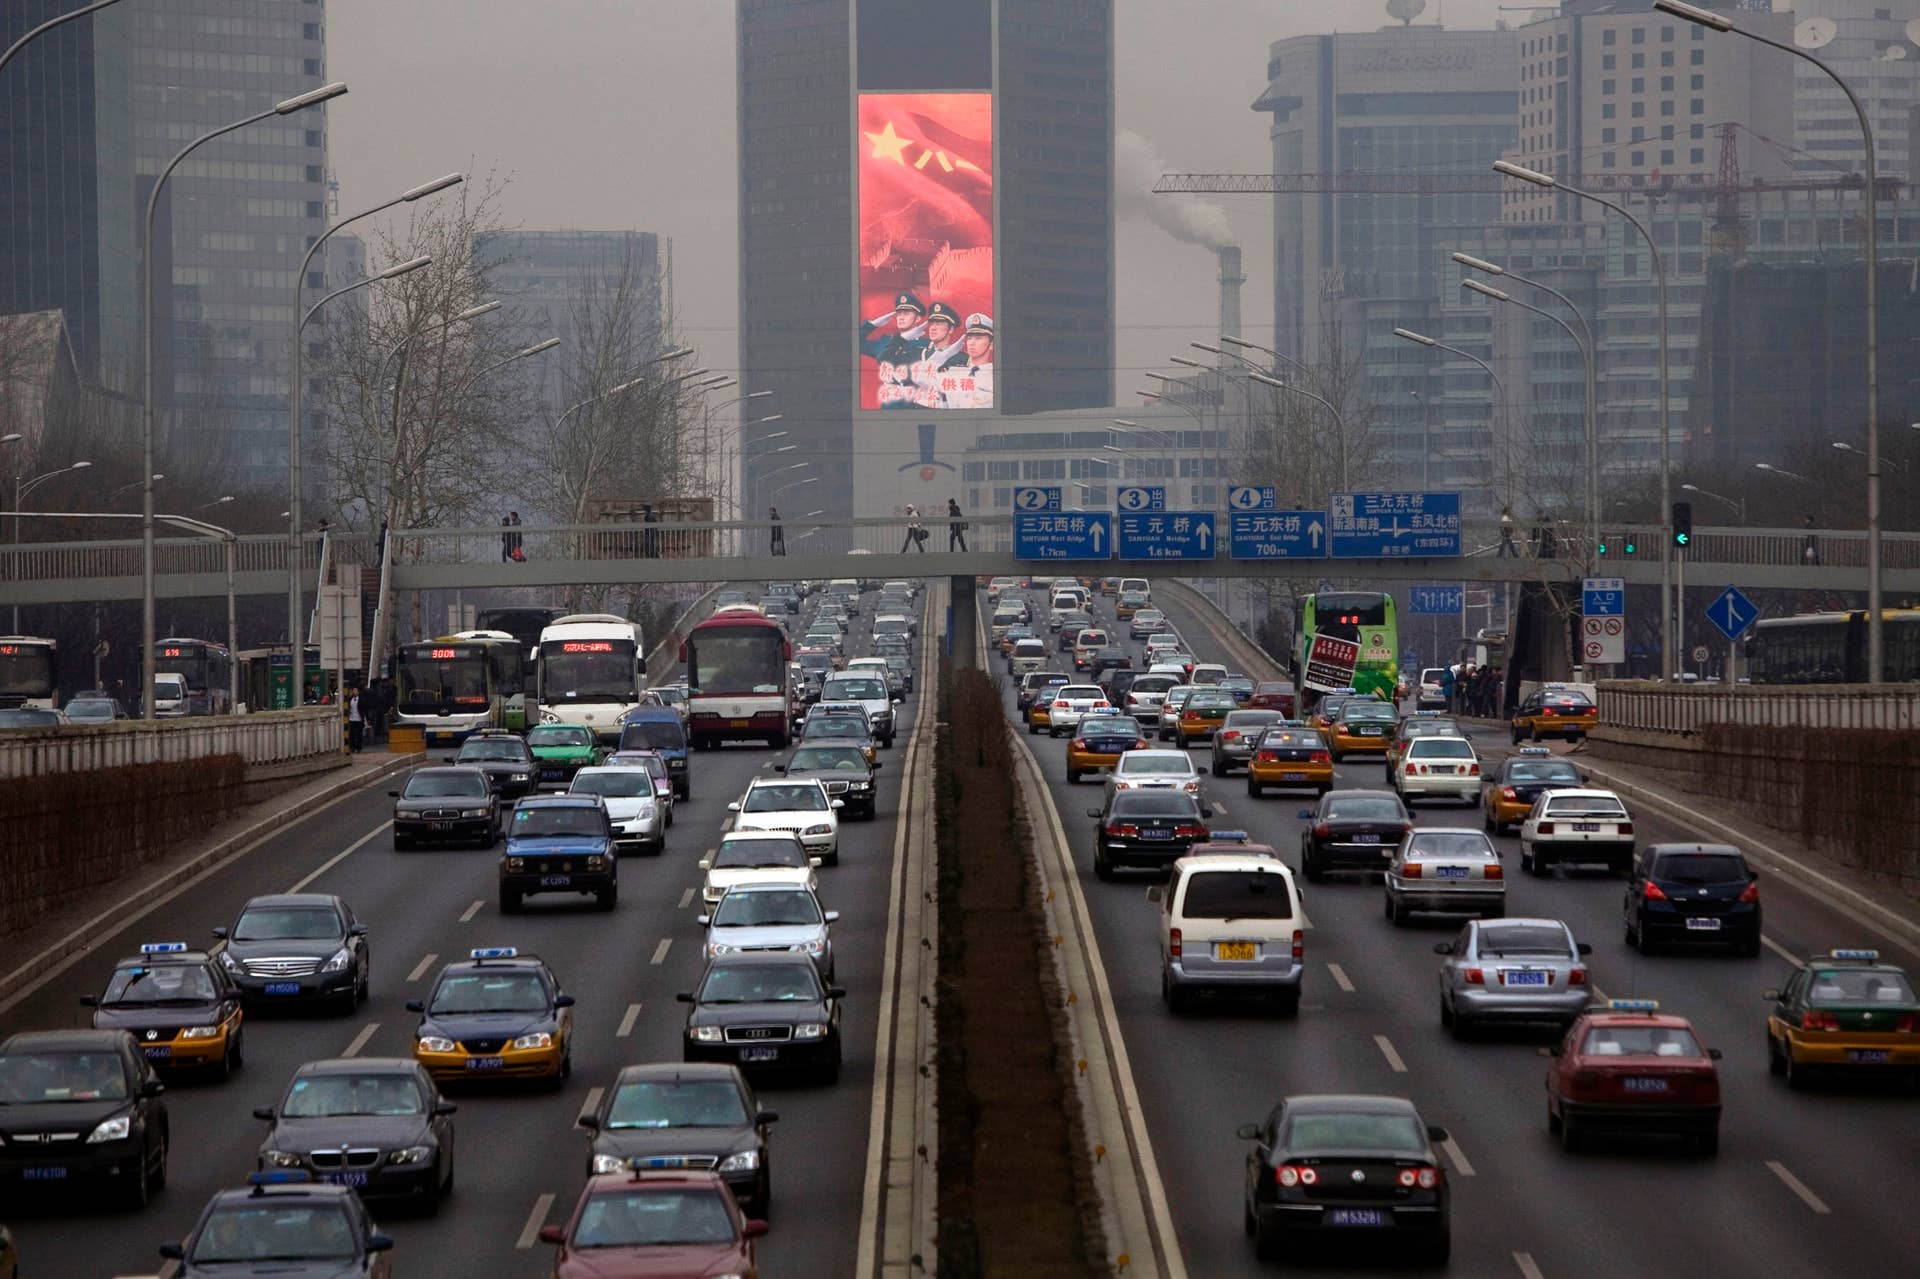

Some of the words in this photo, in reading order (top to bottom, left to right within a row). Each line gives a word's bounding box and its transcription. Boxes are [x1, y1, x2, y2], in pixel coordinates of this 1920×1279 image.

[1353, 48, 1474, 71] Microsoft
[1026, 491, 1038, 507] 2
[1048, 489, 1059, 509] 出口
[1129, 491, 1141, 507] 3
[1152, 489, 1163, 509] 出口
[1240, 490, 1252, 506] 4
[1263, 488, 1274, 508] 出口
[1365, 494, 1424, 508] 三元东桥
[1021, 517, 1086, 532] 三元西桥
[1235, 516, 1301, 532] 三元东桥
[1411, 514, 1459, 528] 东风北桥
[1256, 544, 1287, 556] 700m
